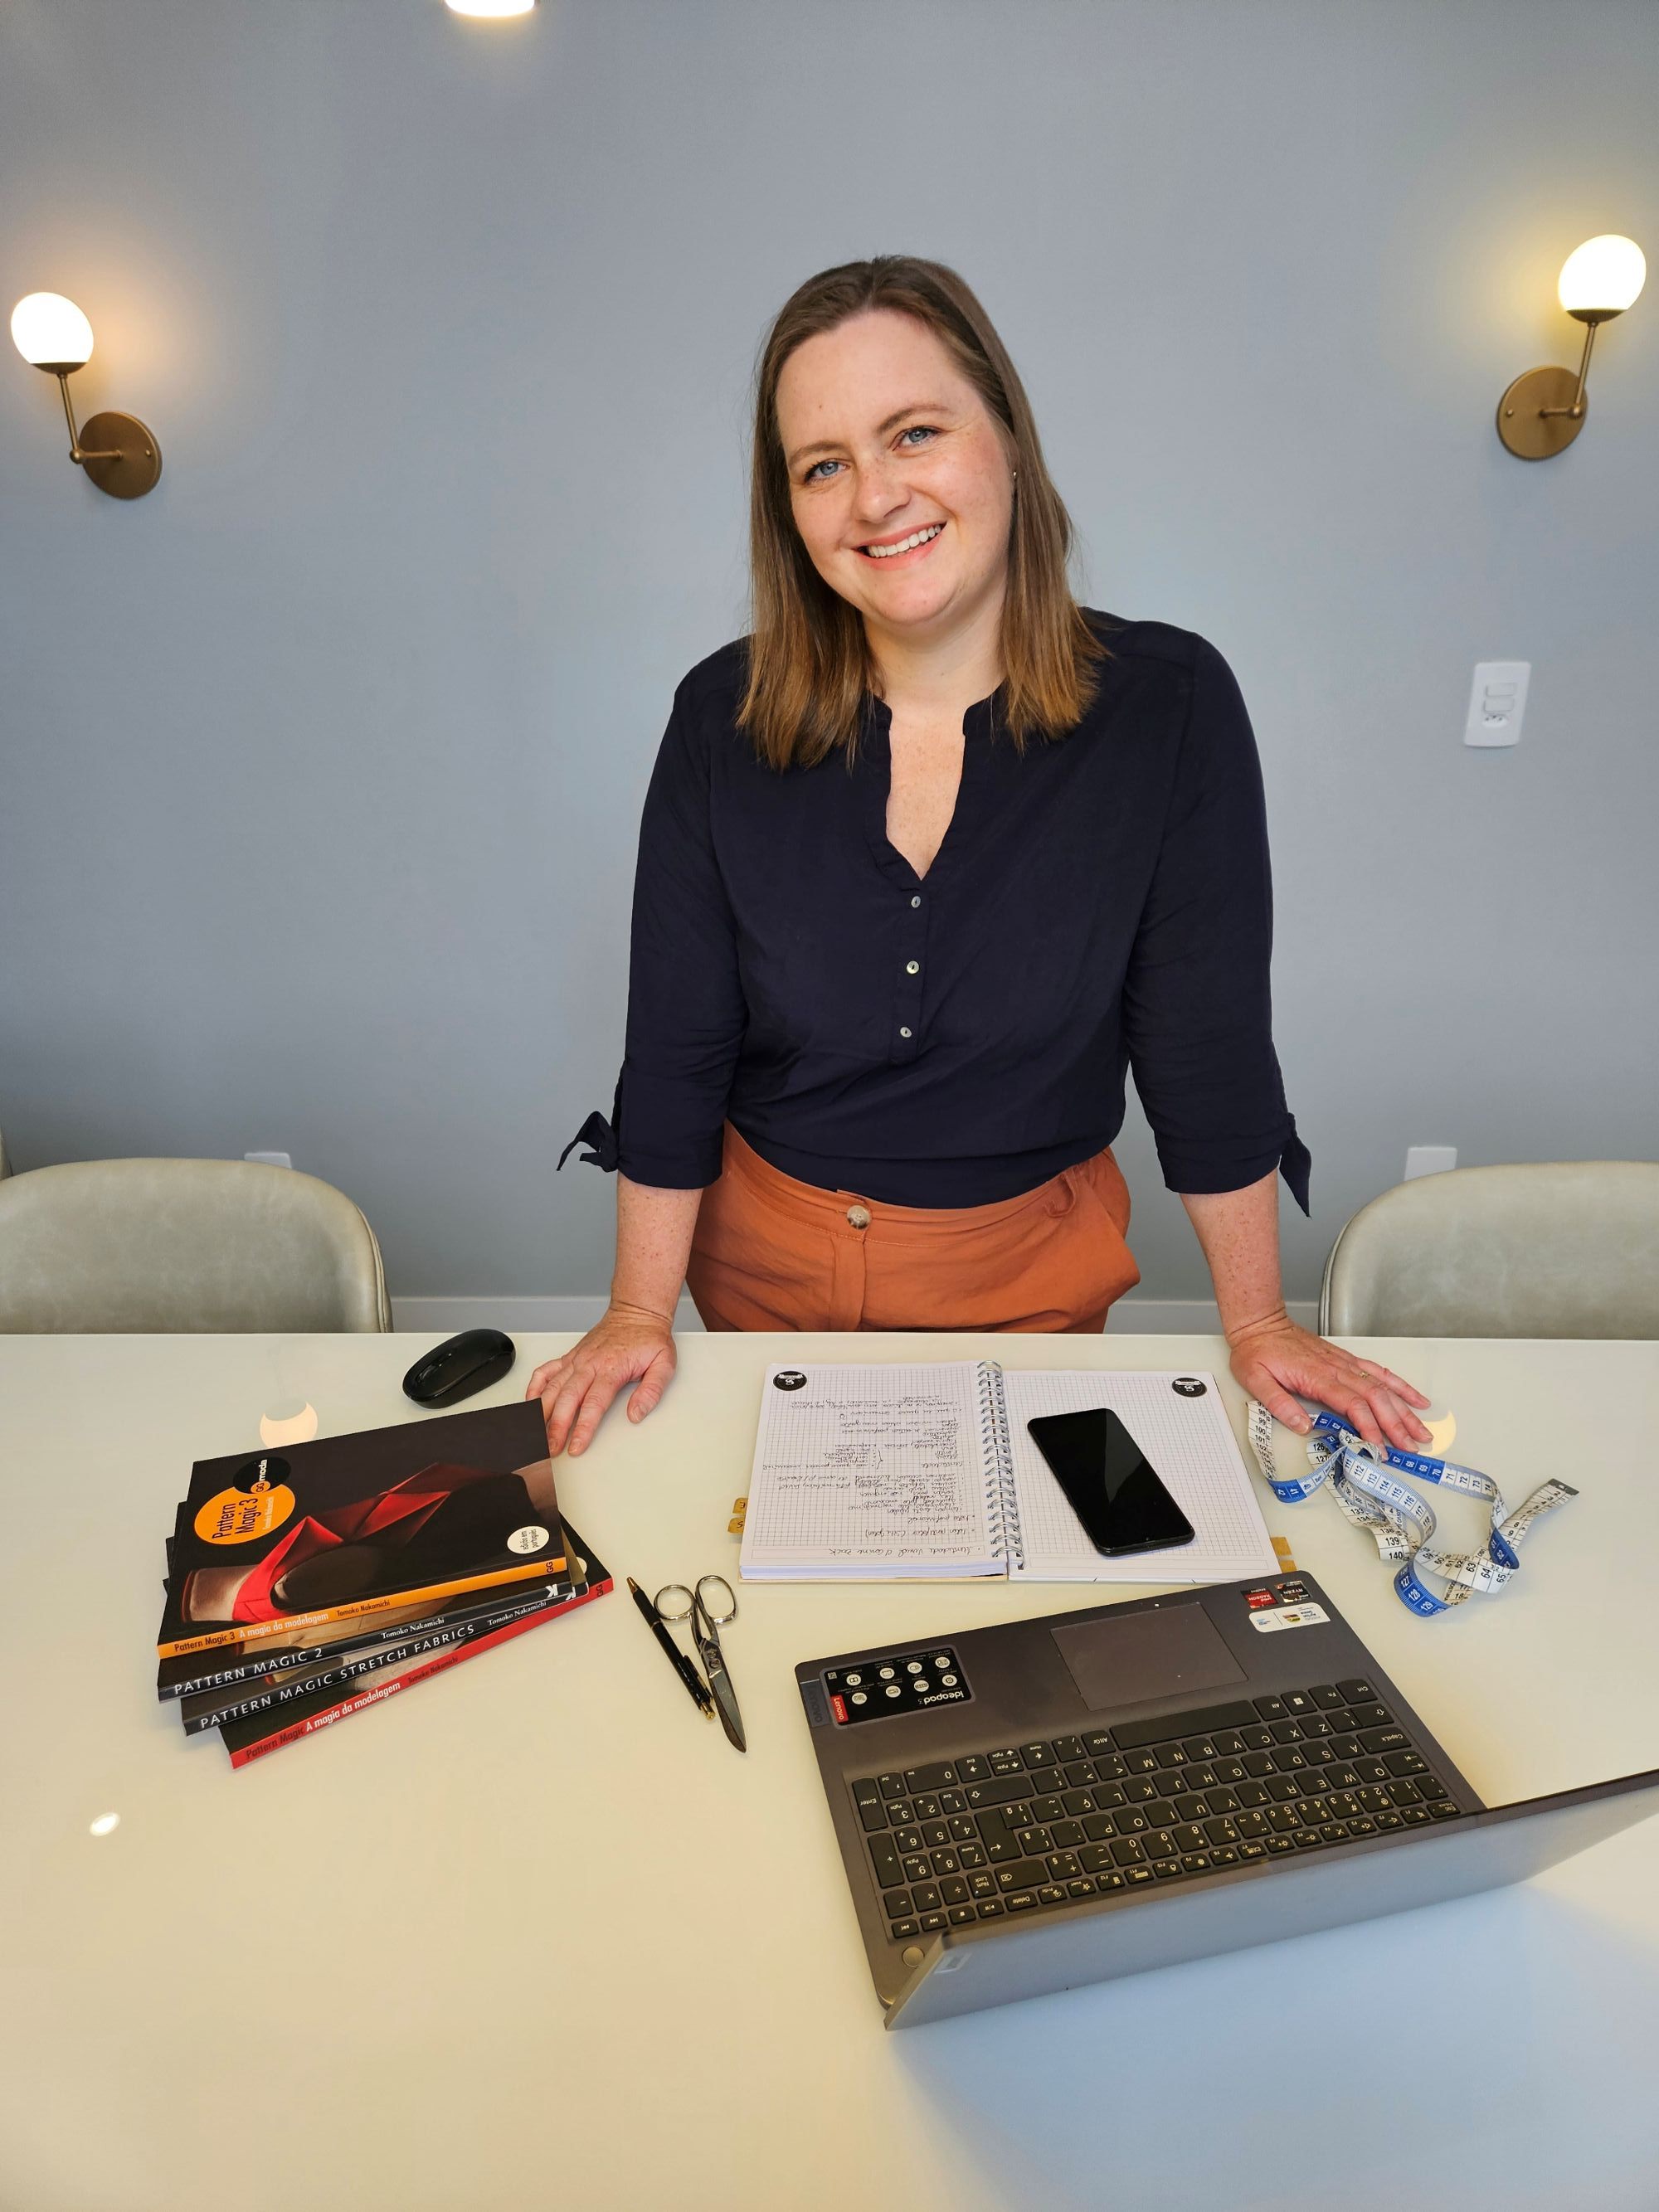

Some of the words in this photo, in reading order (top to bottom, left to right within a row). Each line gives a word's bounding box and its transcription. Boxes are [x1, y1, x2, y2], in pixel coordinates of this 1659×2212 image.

[1256, 1425, 1266, 1435] 100
[1256, 1435, 1266, 1443] 101
[1314, 1443, 1325, 1451] 126
[259, 1460, 268, 1481] moda
[1355, 1465, 1365, 1476] 112
[1367, 1473, 1377, 1485] 113
[1460, 1476, 1468, 1485] 72
[1379, 1480, 1389, 1491] 114
[1392, 1488, 1403, 1498] 115
[1404, 1496, 1414, 1507] 116
[1415, 1506, 1424, 1518] 117
[212, 1503, 236, 1539] Pattern
[235, 1506, 261, 1534] Magic
[1385, 1537, 1399, 1547] 139
[1389, 1551, 1403, 1560] 140
[1467, 1563, 1477, 1573] 63
[1481, 1568, 1491, 1579] 64
[1401, 1576, 1410, 1587] 127
[1408, 1589, 1421, 1602] 128
[174, 1641, 203, 1652] Pattern
[205, 1635, 227, 1647] Magic
[231, 1632, 236, 1641] 3
[240, 1631, 246, 1639] A
[247, 1626, 271, 1637] magia
[273, 1622, 283, 1631] da
[285, 1613, 328, 1629] modelagem
[337, 1609, 359, 1617] Tomoko
[360, 1599, 391, 1612] Nakamichi
[546, 1561, 554, 1573] GG
[174, 1667, 246, 1694] PATTERN
[254, 1650, 307, 1675] MAGIC
[315, 1648, 324, 1658] 2
[381, 1626, 409, 1640] Tomoko
[410, 1617, 445, 1633] Nakamichi
[201, 1695, 271, 1728] PATTERN
[280, 1674, 333, 1701] MAGIC
[340, 1649, 407, 1679] STRETCH
[415, 1625, 474, 1653] FABRICS
[488, 1613, 513, 1626] Tomoko
[514, 1601, 547, 1618] Nakamichi
[924, 1690, 965, 1705] ideapad
[834, 1697, 844, 1720] Lenovo
[246, 1739, 278, 1760] Pattern
[280, 1728, 304, 1747] Magic
[306, 1722, 314, 1732] A
[315, 1710, 340, 1728] magia
[342, 1704, 353, 1715] da
[355, 1682, 401, 1709] modelagem
[1204, 1774, 1213, 1782] H
[1345, 1774, 1355, 1782] W
[1084, 1799, 1091, 1807] Ç
[1197, 1805, 1205, 1813] U
[1134, 1818, 1143, 1826] O
[975, 1854, 980, 1862] 7
[946, 1860, 953, 1868] 8
